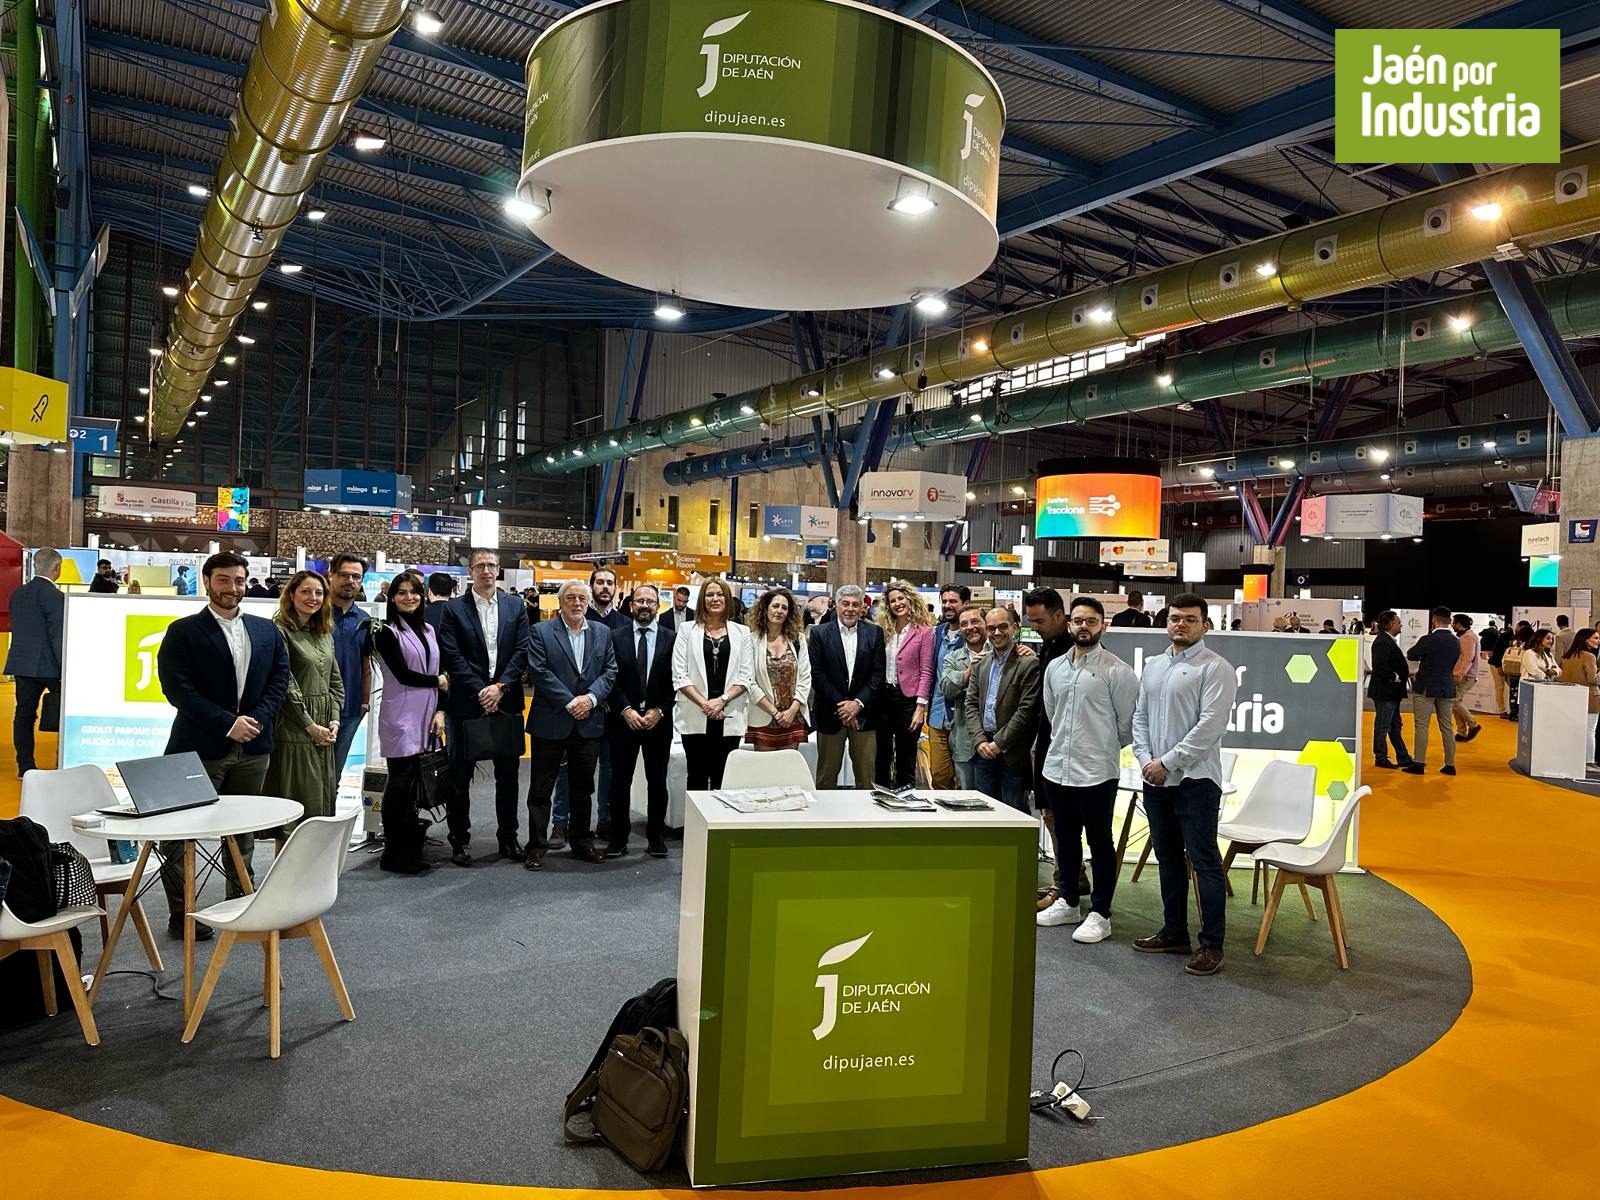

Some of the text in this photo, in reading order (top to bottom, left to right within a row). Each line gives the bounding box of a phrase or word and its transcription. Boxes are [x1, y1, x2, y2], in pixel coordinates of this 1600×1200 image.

[722, 53, 801, 70] DIPUTACIÓN
[722, 67, 774, 81] DE JAÉN
[704, 110, 786, 128] dipujaen.es
[79, 429, 87, 439] 2
[98, 435, 108, 451] 1
[151, 496, 179, 506] Castilla
[676, 555, 702, 563] Science
[676, 561, 695, 569] Room
[842, 981, 931, 997] DIPUTACIÓN
[842, 998, 901, 1014] DE JAÉN
[823, 1054, 915, 1073] dipujaen.es
